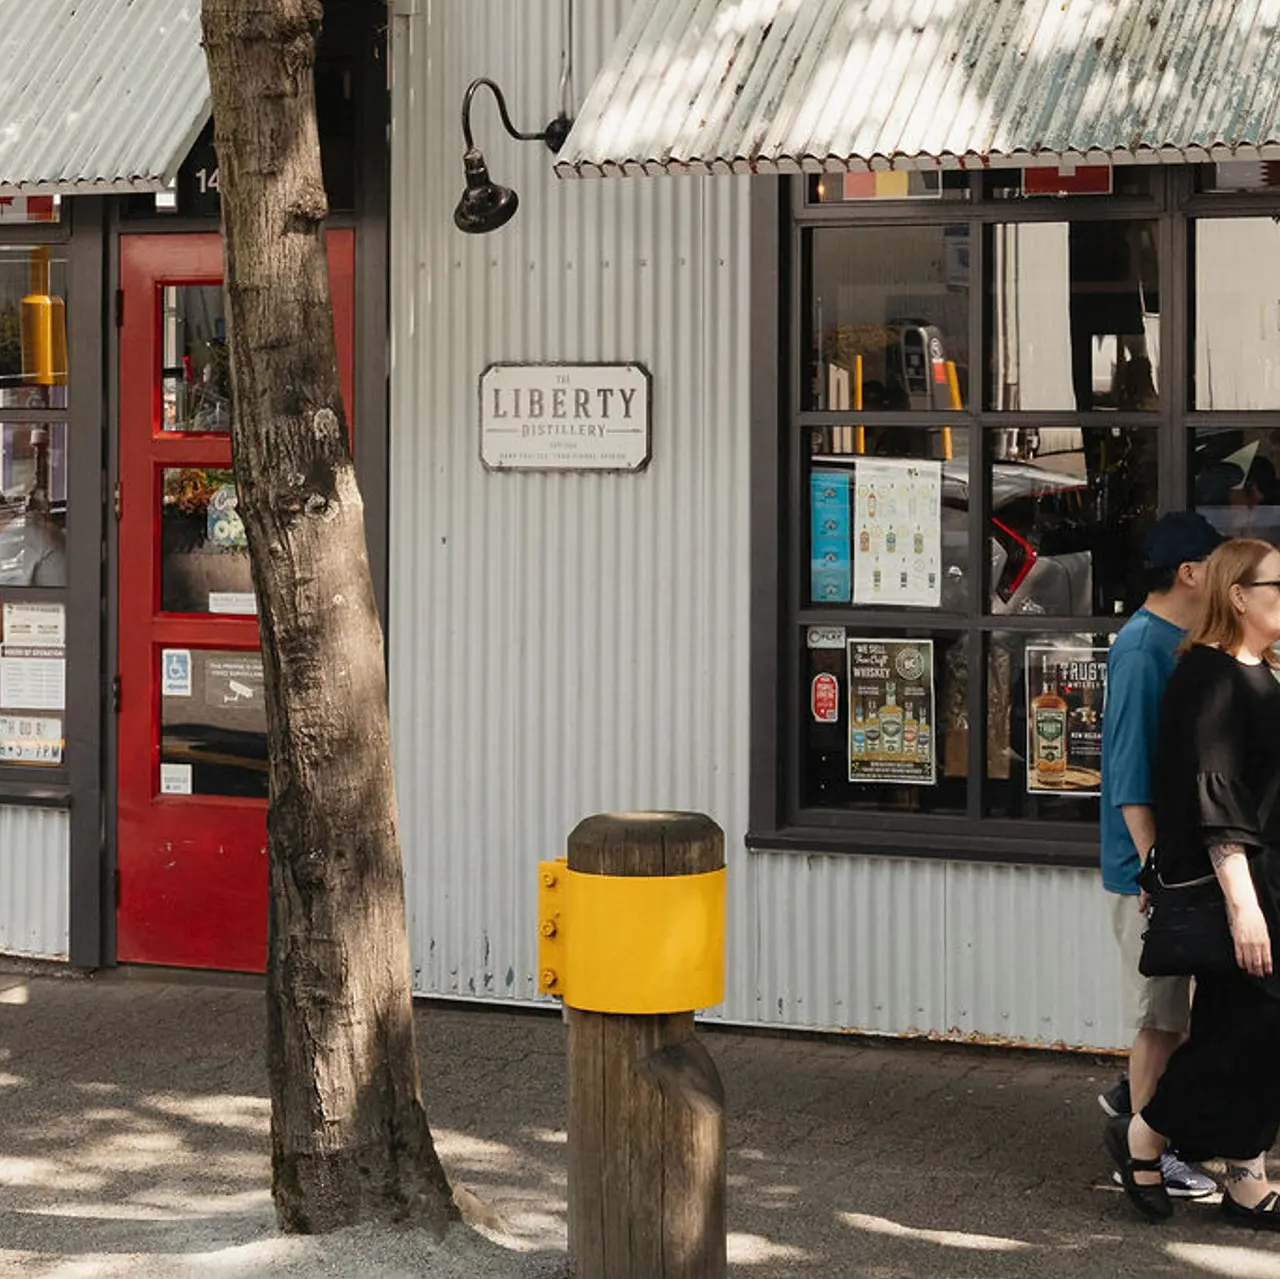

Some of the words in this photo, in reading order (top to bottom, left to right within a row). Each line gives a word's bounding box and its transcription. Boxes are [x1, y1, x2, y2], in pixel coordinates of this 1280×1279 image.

[493, 388, 638, 419] LIBERTY
[521, 424, 607, 438] DISTILLERY
[1060, 663, 1107, 681] TRUST
